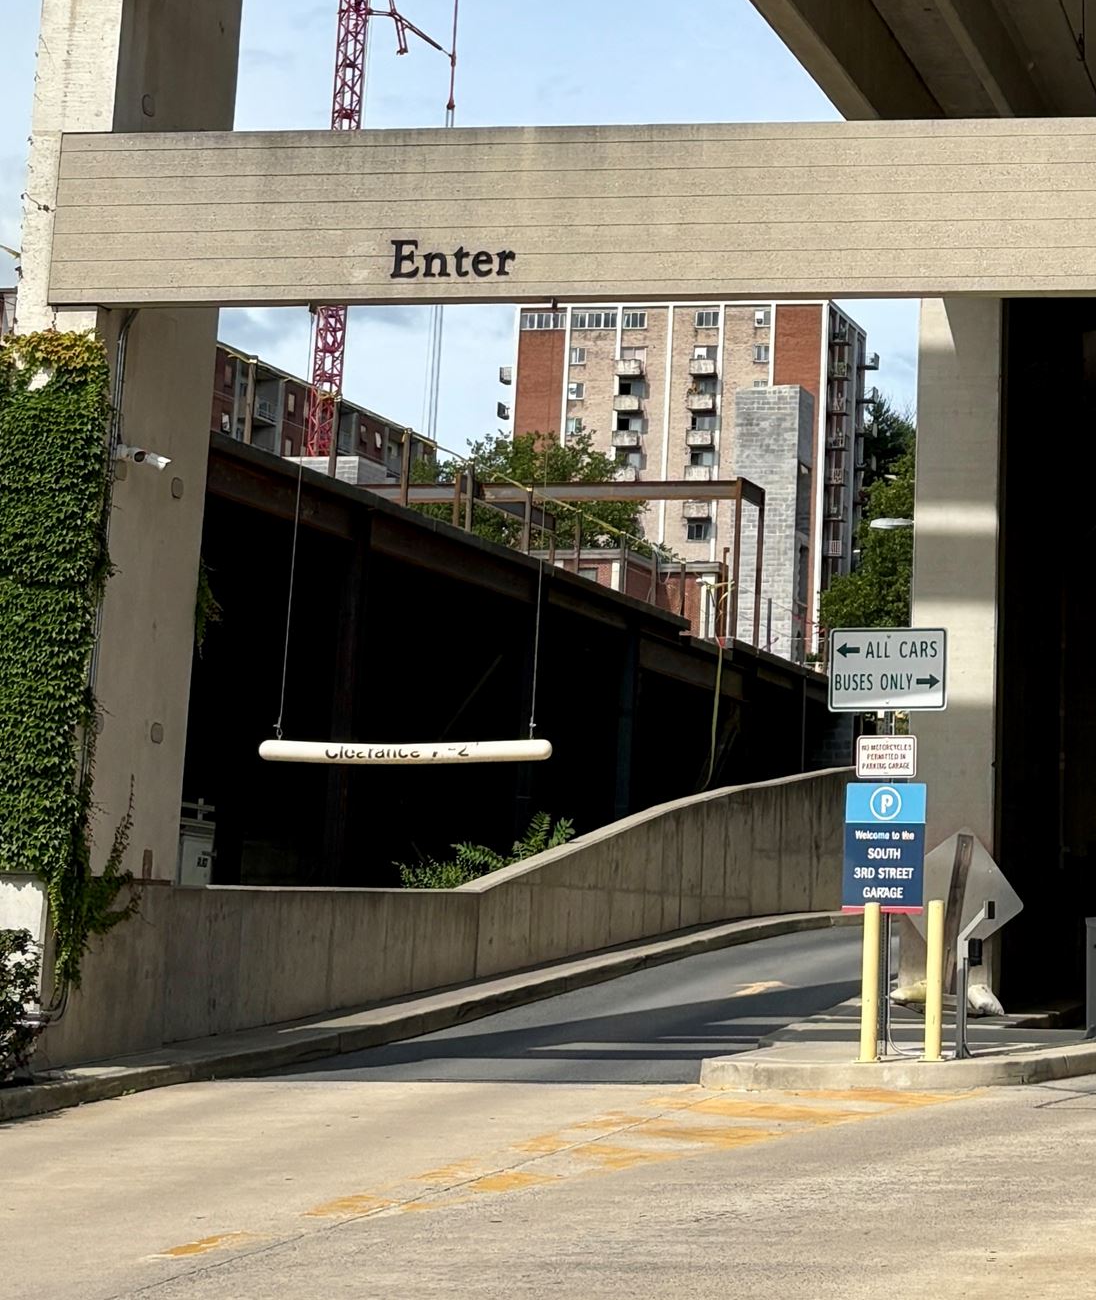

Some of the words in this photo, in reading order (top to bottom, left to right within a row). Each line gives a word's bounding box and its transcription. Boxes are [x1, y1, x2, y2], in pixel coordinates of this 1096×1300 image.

[389, 239, 517, 279] Enter
[865, 641, 891, 659] ALL
[899, 640, 938, 659] CARS
[834, 673, 873, 691] BUSES
[880, 673, 913, 691] ONLY
[861, 762, 887, 770] PARKING
[888, 762, 910, 770] GARAGE
[880, 794, 894, 814] P
[855, 830, 890, 840] Welcome
[891, 831, 900, 840] to
[901, 830, 915, 840] the
[867, 847, 901, 860] SOUTH
[853, 866, 876, 879] 3RD
[877, 867, 914, 879] STREET
[862, 886, 904, 899] GARAGE
